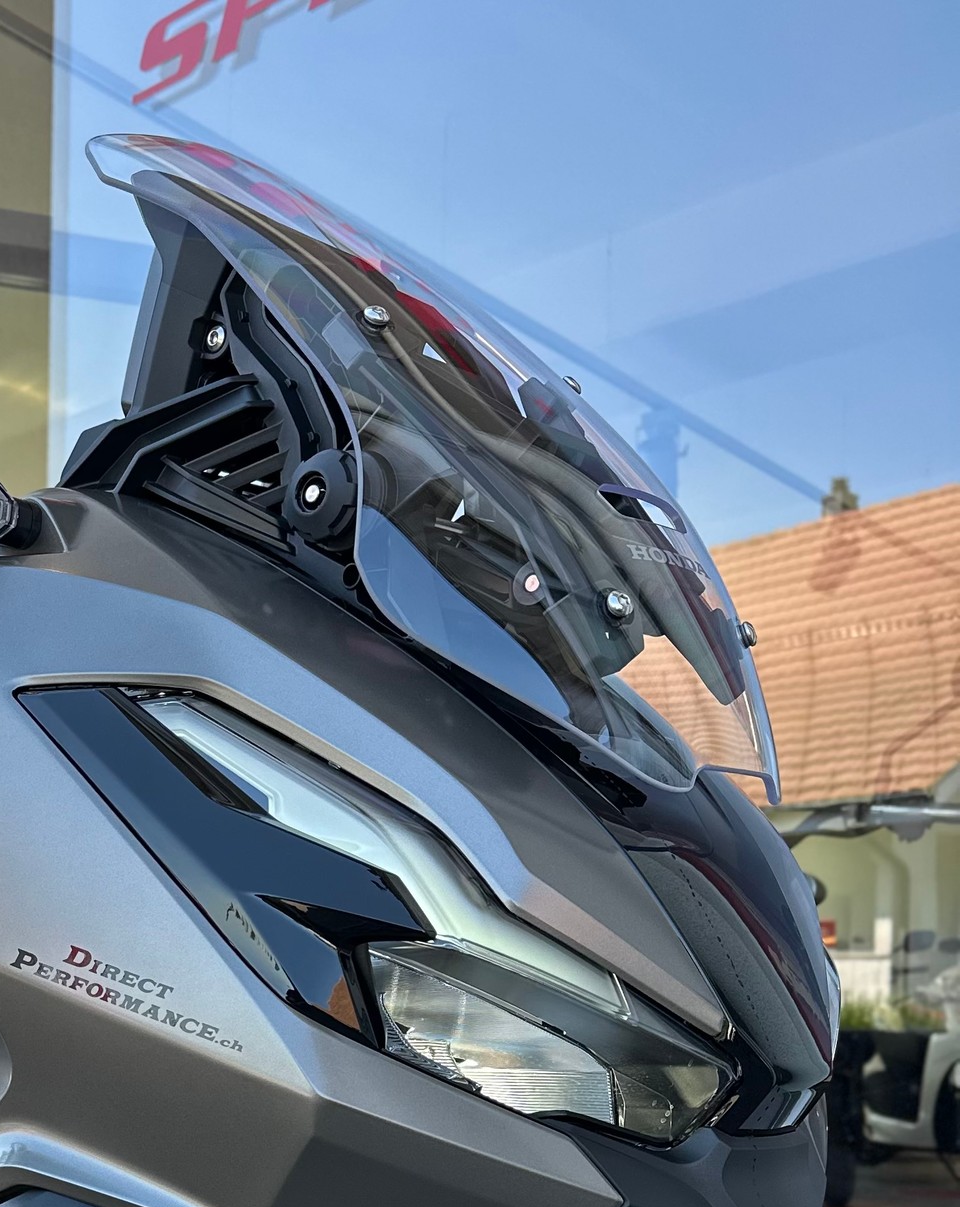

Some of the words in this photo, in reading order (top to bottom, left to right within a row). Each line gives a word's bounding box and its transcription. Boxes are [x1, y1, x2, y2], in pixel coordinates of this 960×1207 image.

[626, 544, 711, 580] HONDA
[62, 944, 174, 1000] DIRECT
[9, 948, 244, 1053] PERFORMANCE.ch
